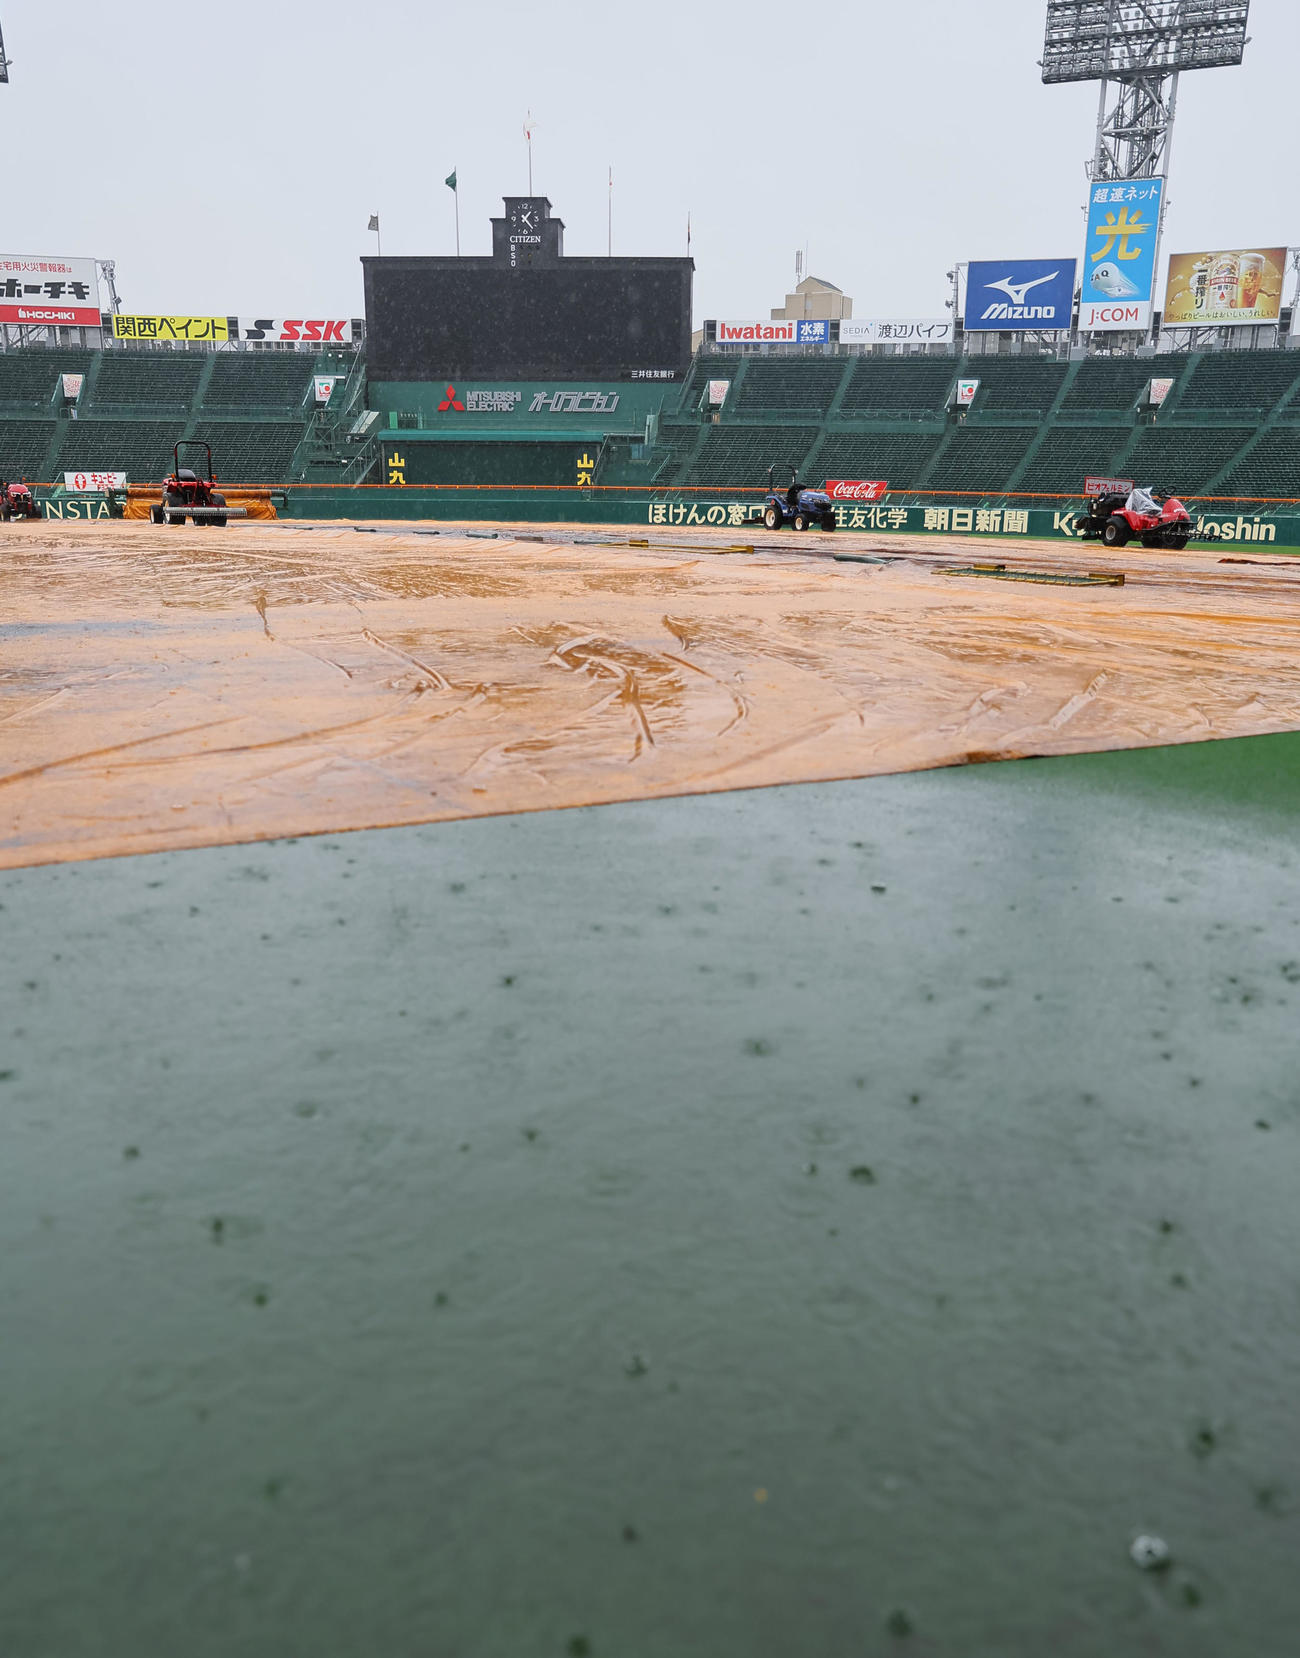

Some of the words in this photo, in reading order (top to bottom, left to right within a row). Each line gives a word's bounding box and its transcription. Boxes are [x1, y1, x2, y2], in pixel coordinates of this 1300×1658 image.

[1092, 185, 1159, 203] 超速ネット
[509, 235, 542, 243] CITIZEN
[1090, 206, 1154, 263] 光
[0, 261, 72, 273] 宅用火災警報器は
[1194, 269, 1208, 309] 一番搾り
[26, 311, 76, 320] HOCHIKI
[1088, 307, 1139, 326] J:COM
[115, 317, 226, 339] 関西ペイント
[280, 320, 347, 341] SSK
[720, 322, 793, 340] Iwatani
[801, 322, 825, 335] 水素
[878, 322, 953, 339] 渡辺パイプ
[631, 369, 675, 379] 三井住友銀行
[466, 391, 522, 401] MITSUBISHI
[466, 401, 515, 411] ELECTRIC
[388, 452, 406, 485] 山九
[833, 481, 879, 498] Coca-Cola
[923, 508, 1029, 534] 朝日新聞
